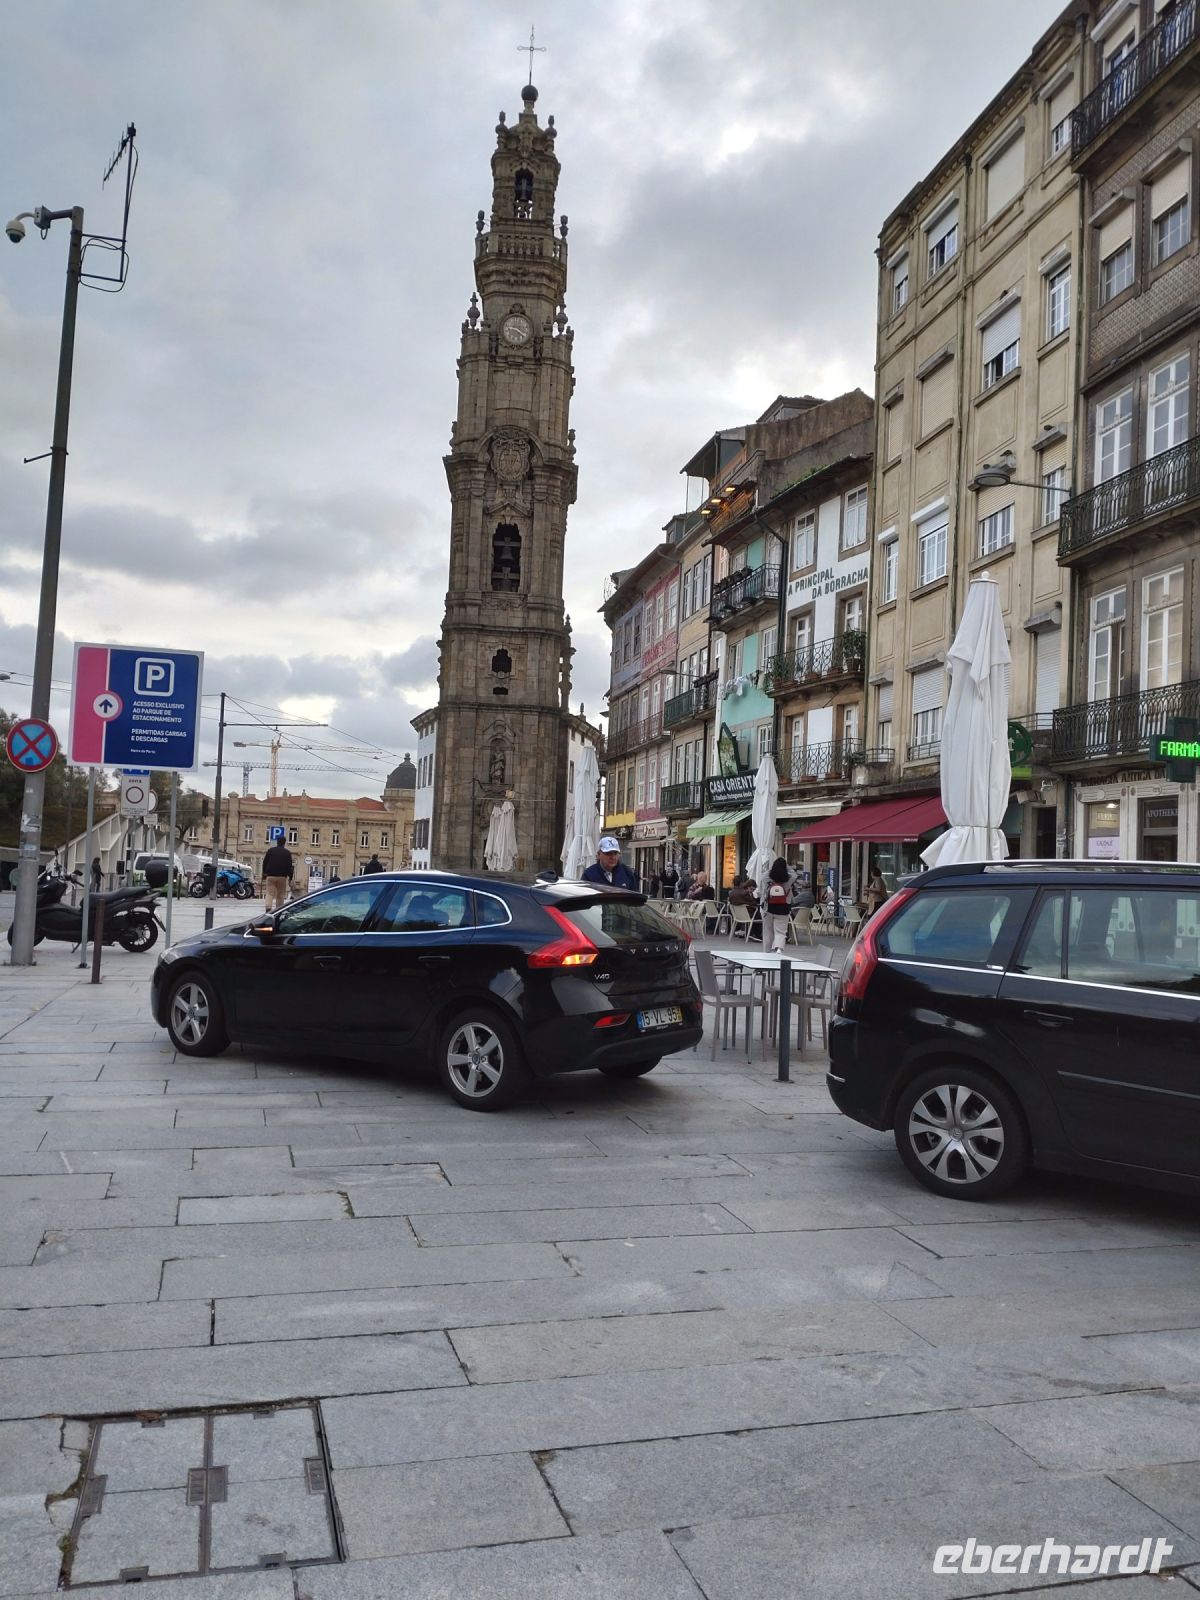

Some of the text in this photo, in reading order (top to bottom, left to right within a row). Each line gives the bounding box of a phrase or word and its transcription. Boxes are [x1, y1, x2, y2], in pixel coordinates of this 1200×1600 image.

[787, 567, 835, 597] A PRINCIPAL
[811, 567, 869, 600] DA BORRACHA
[146, 664, 166, 689] P
[132, 700, 185, 710] ACESSO EXCLUSIVO
[141, 708, 164, 716] PARQUE
[132, 714, 182, 723] ESTACIONAMENTO
[131, 728, 187, 738] PERMITIDAS CARGAS
[135, 735, 169, 743] DESCARGAS
[1160, 740, 1200, 758] FARMÁ
[709, 779, 726, 794] CASA
[272, 828, 282, 840] P
